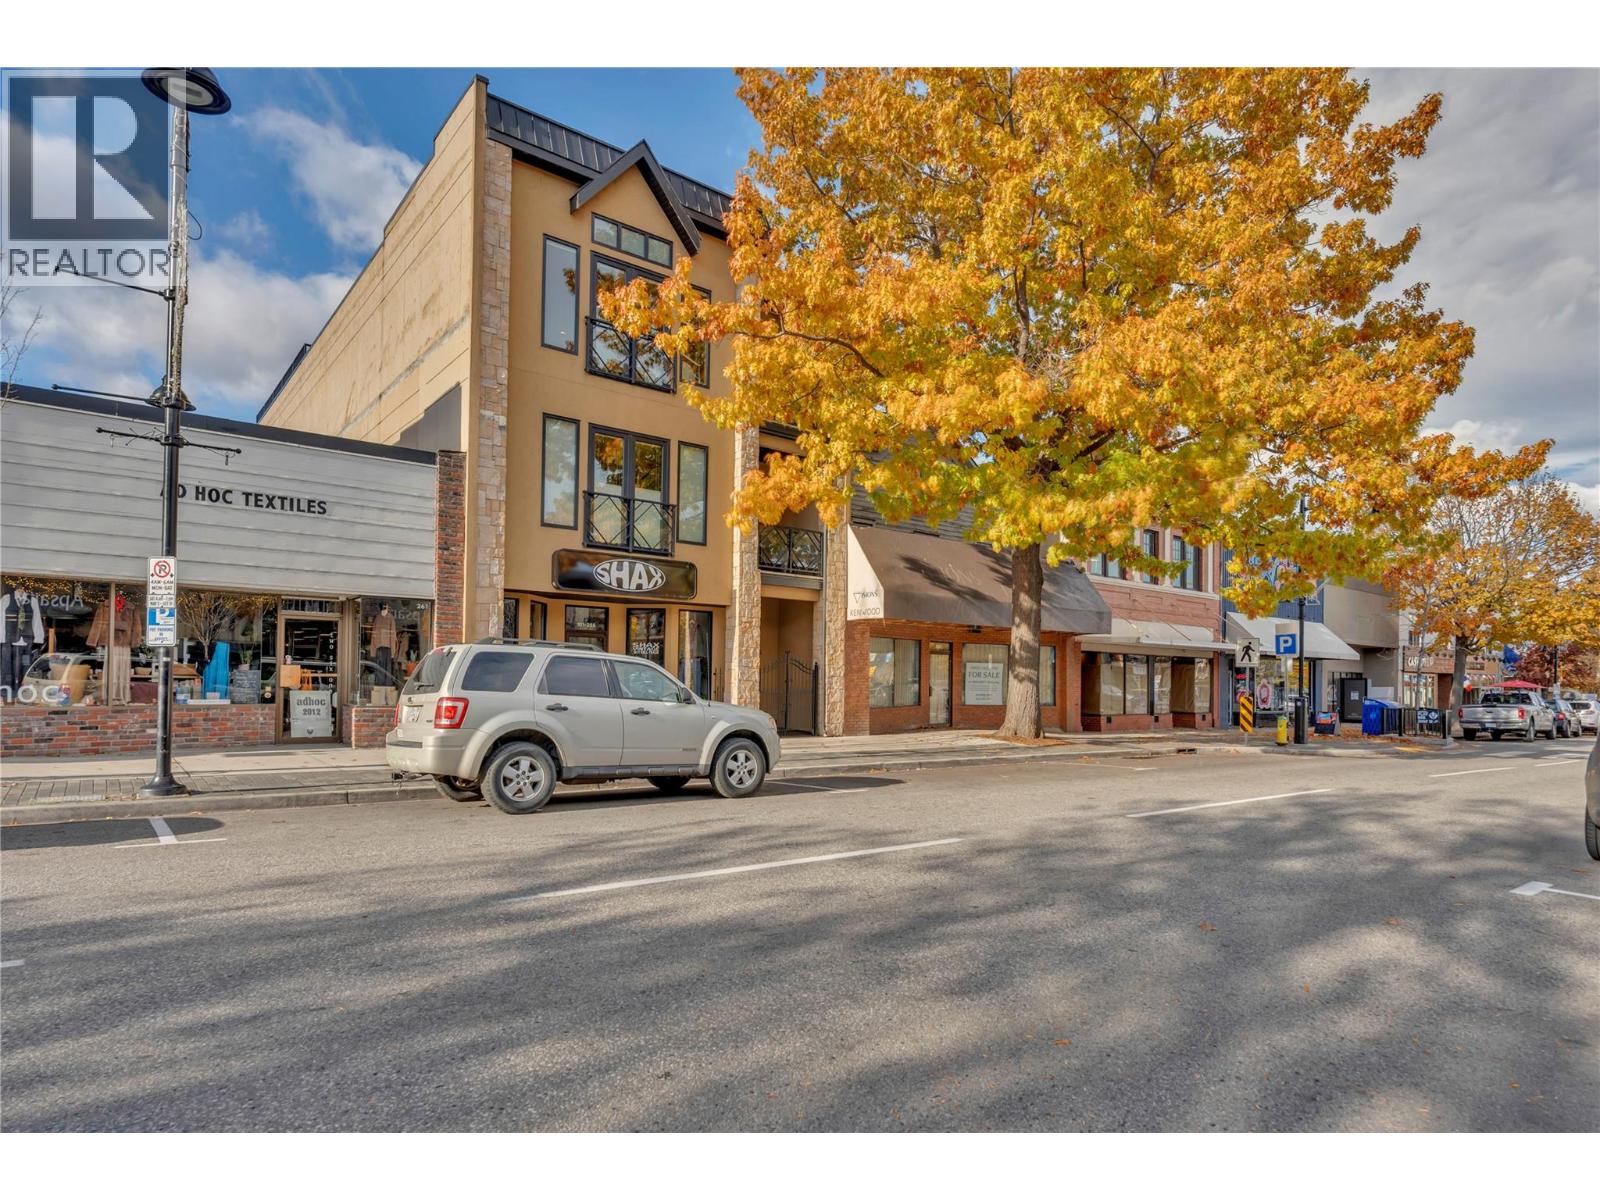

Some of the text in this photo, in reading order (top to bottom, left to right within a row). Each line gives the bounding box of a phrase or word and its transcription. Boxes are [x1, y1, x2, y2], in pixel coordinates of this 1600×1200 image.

[160, 484, 327, 515] D HOC TEXTILES
[596, 561, 662, 590] SHAX
[850, 607, 880, 617] KENWOOD
[968, 671, 1000, 679] FOR SALE
[296, 696, 326, 706] adhoc
[302, 708, 321, 716] 2012
